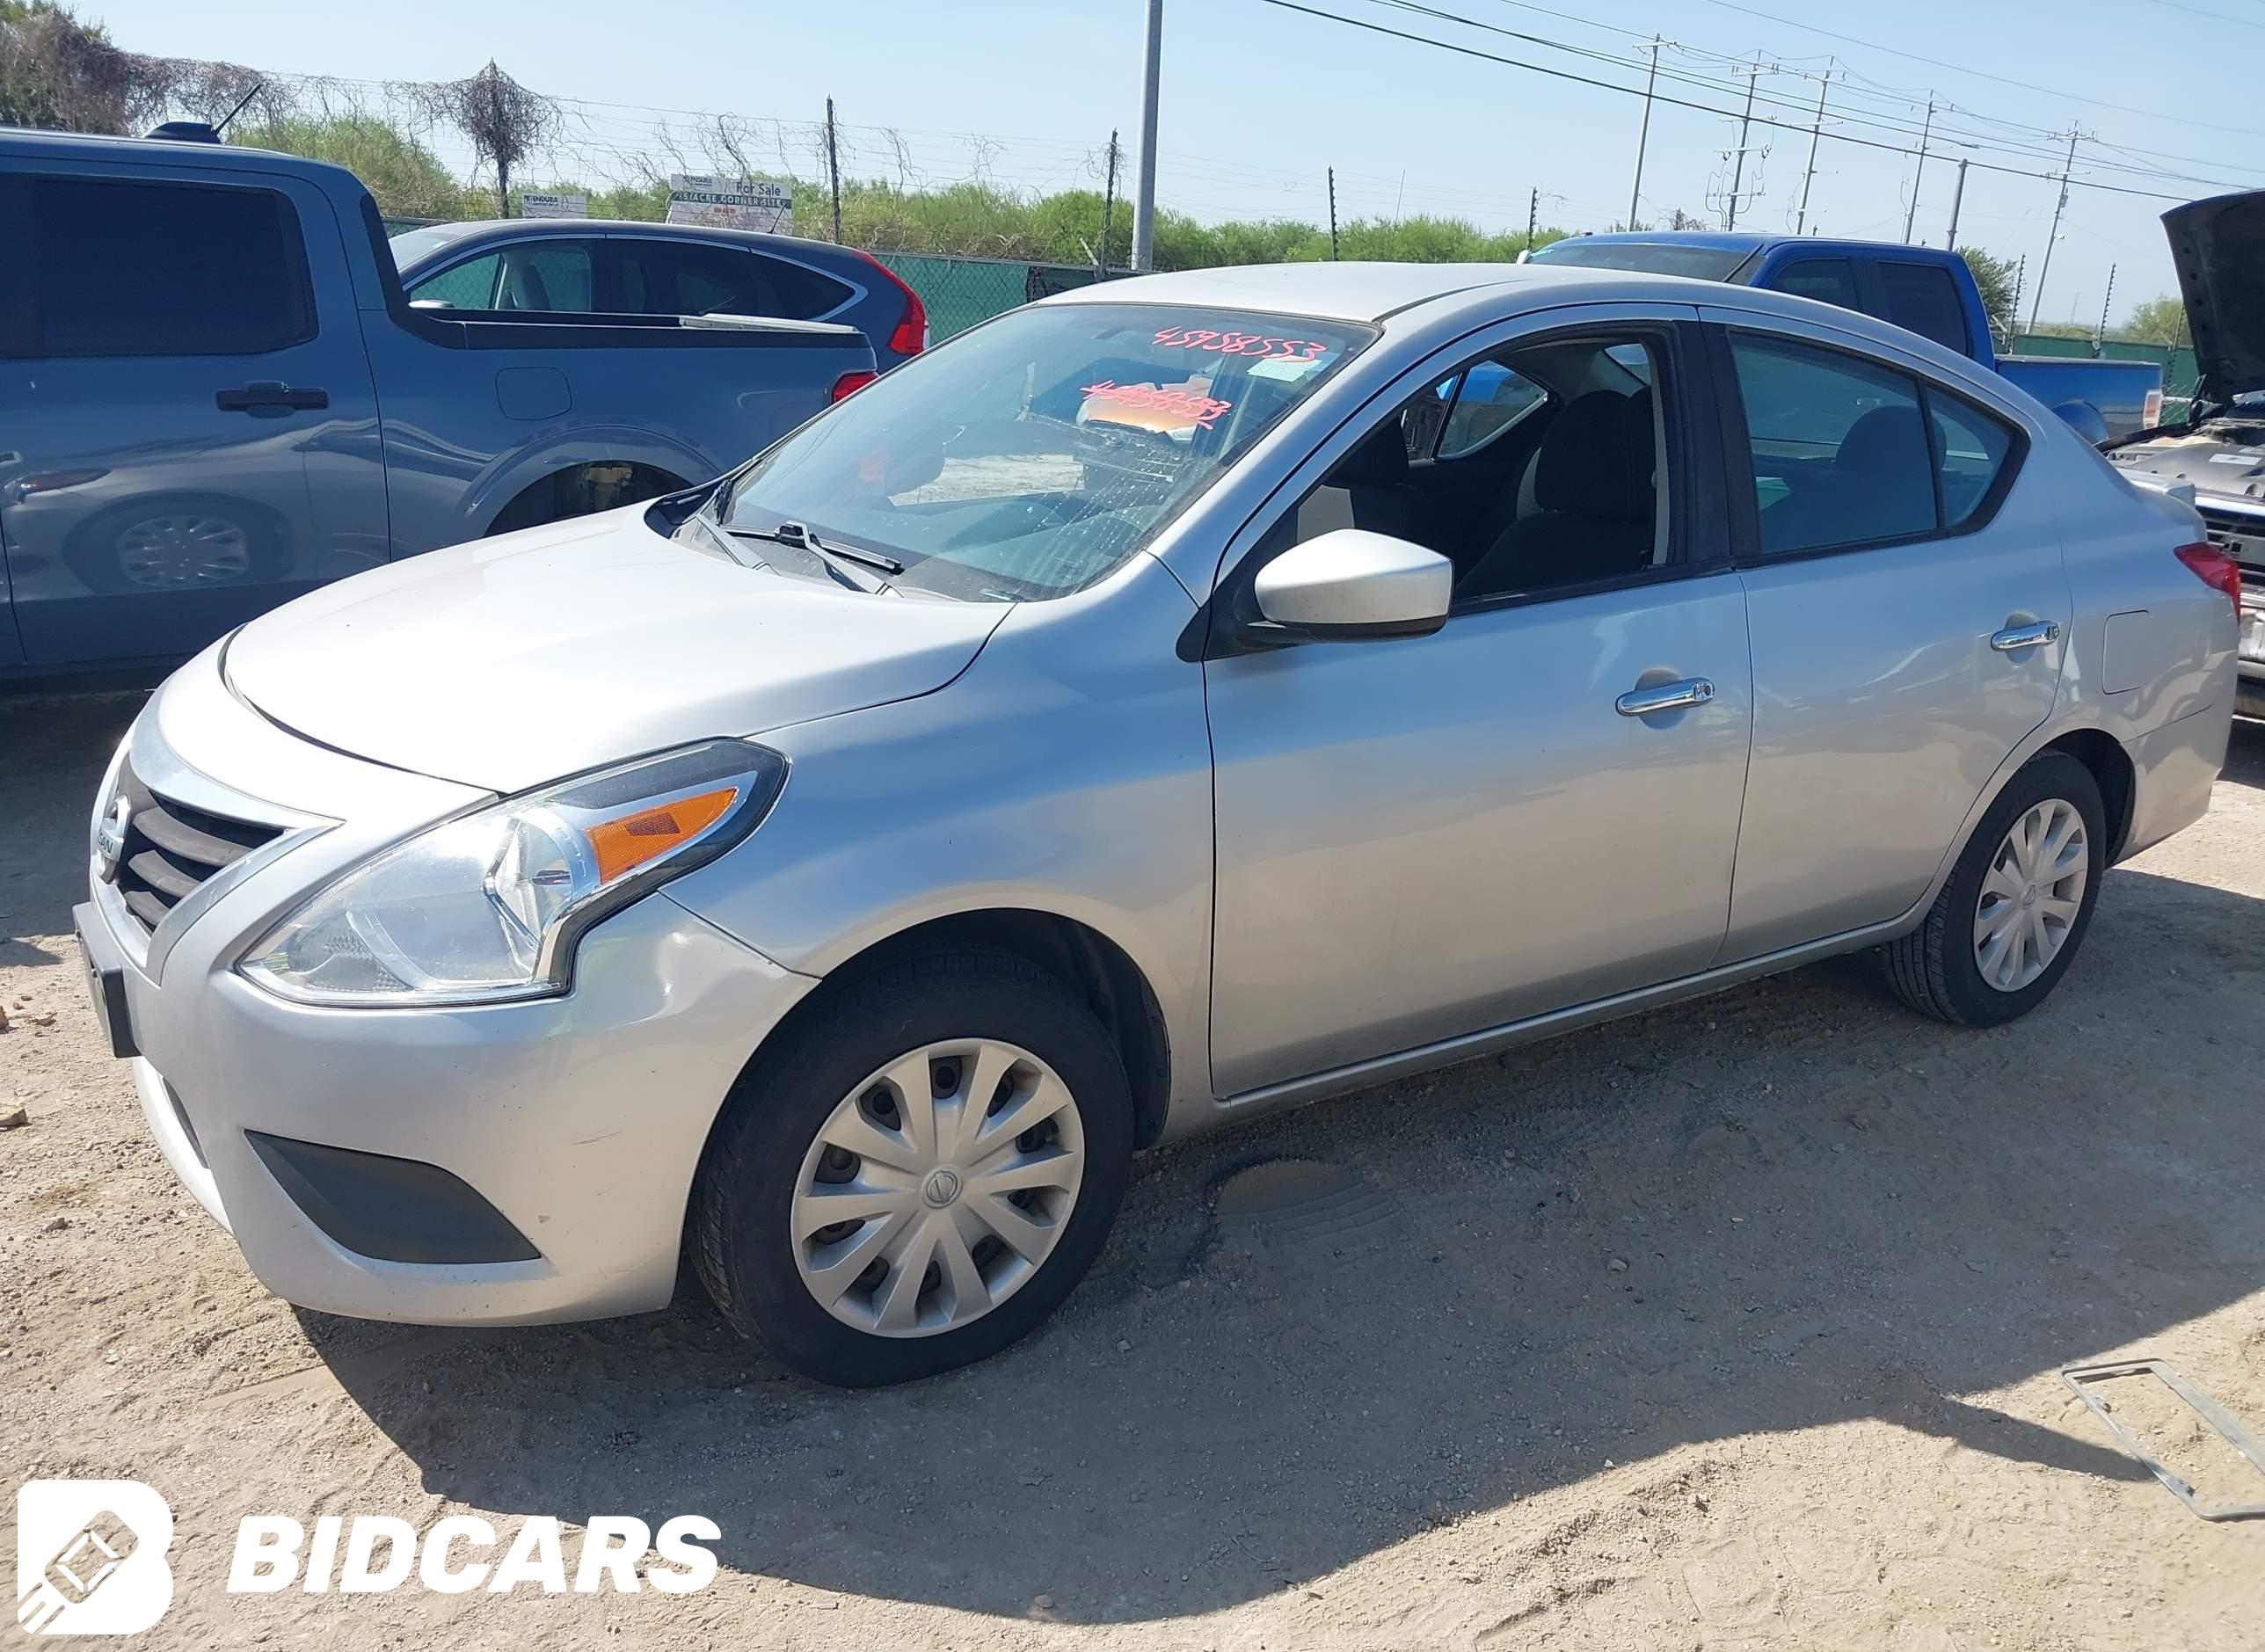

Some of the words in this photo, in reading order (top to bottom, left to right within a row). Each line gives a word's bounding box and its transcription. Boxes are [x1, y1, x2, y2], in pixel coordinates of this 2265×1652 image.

[736, 181, 755, 194] For
[759, 183, 782, 197] Sale
[693, 193, 717, 203] ACRE
[721, 195, 758, 206] CORNER
[761, 198, 781, 207] SITE
[1152, 325, 1327, 362] 45958553
